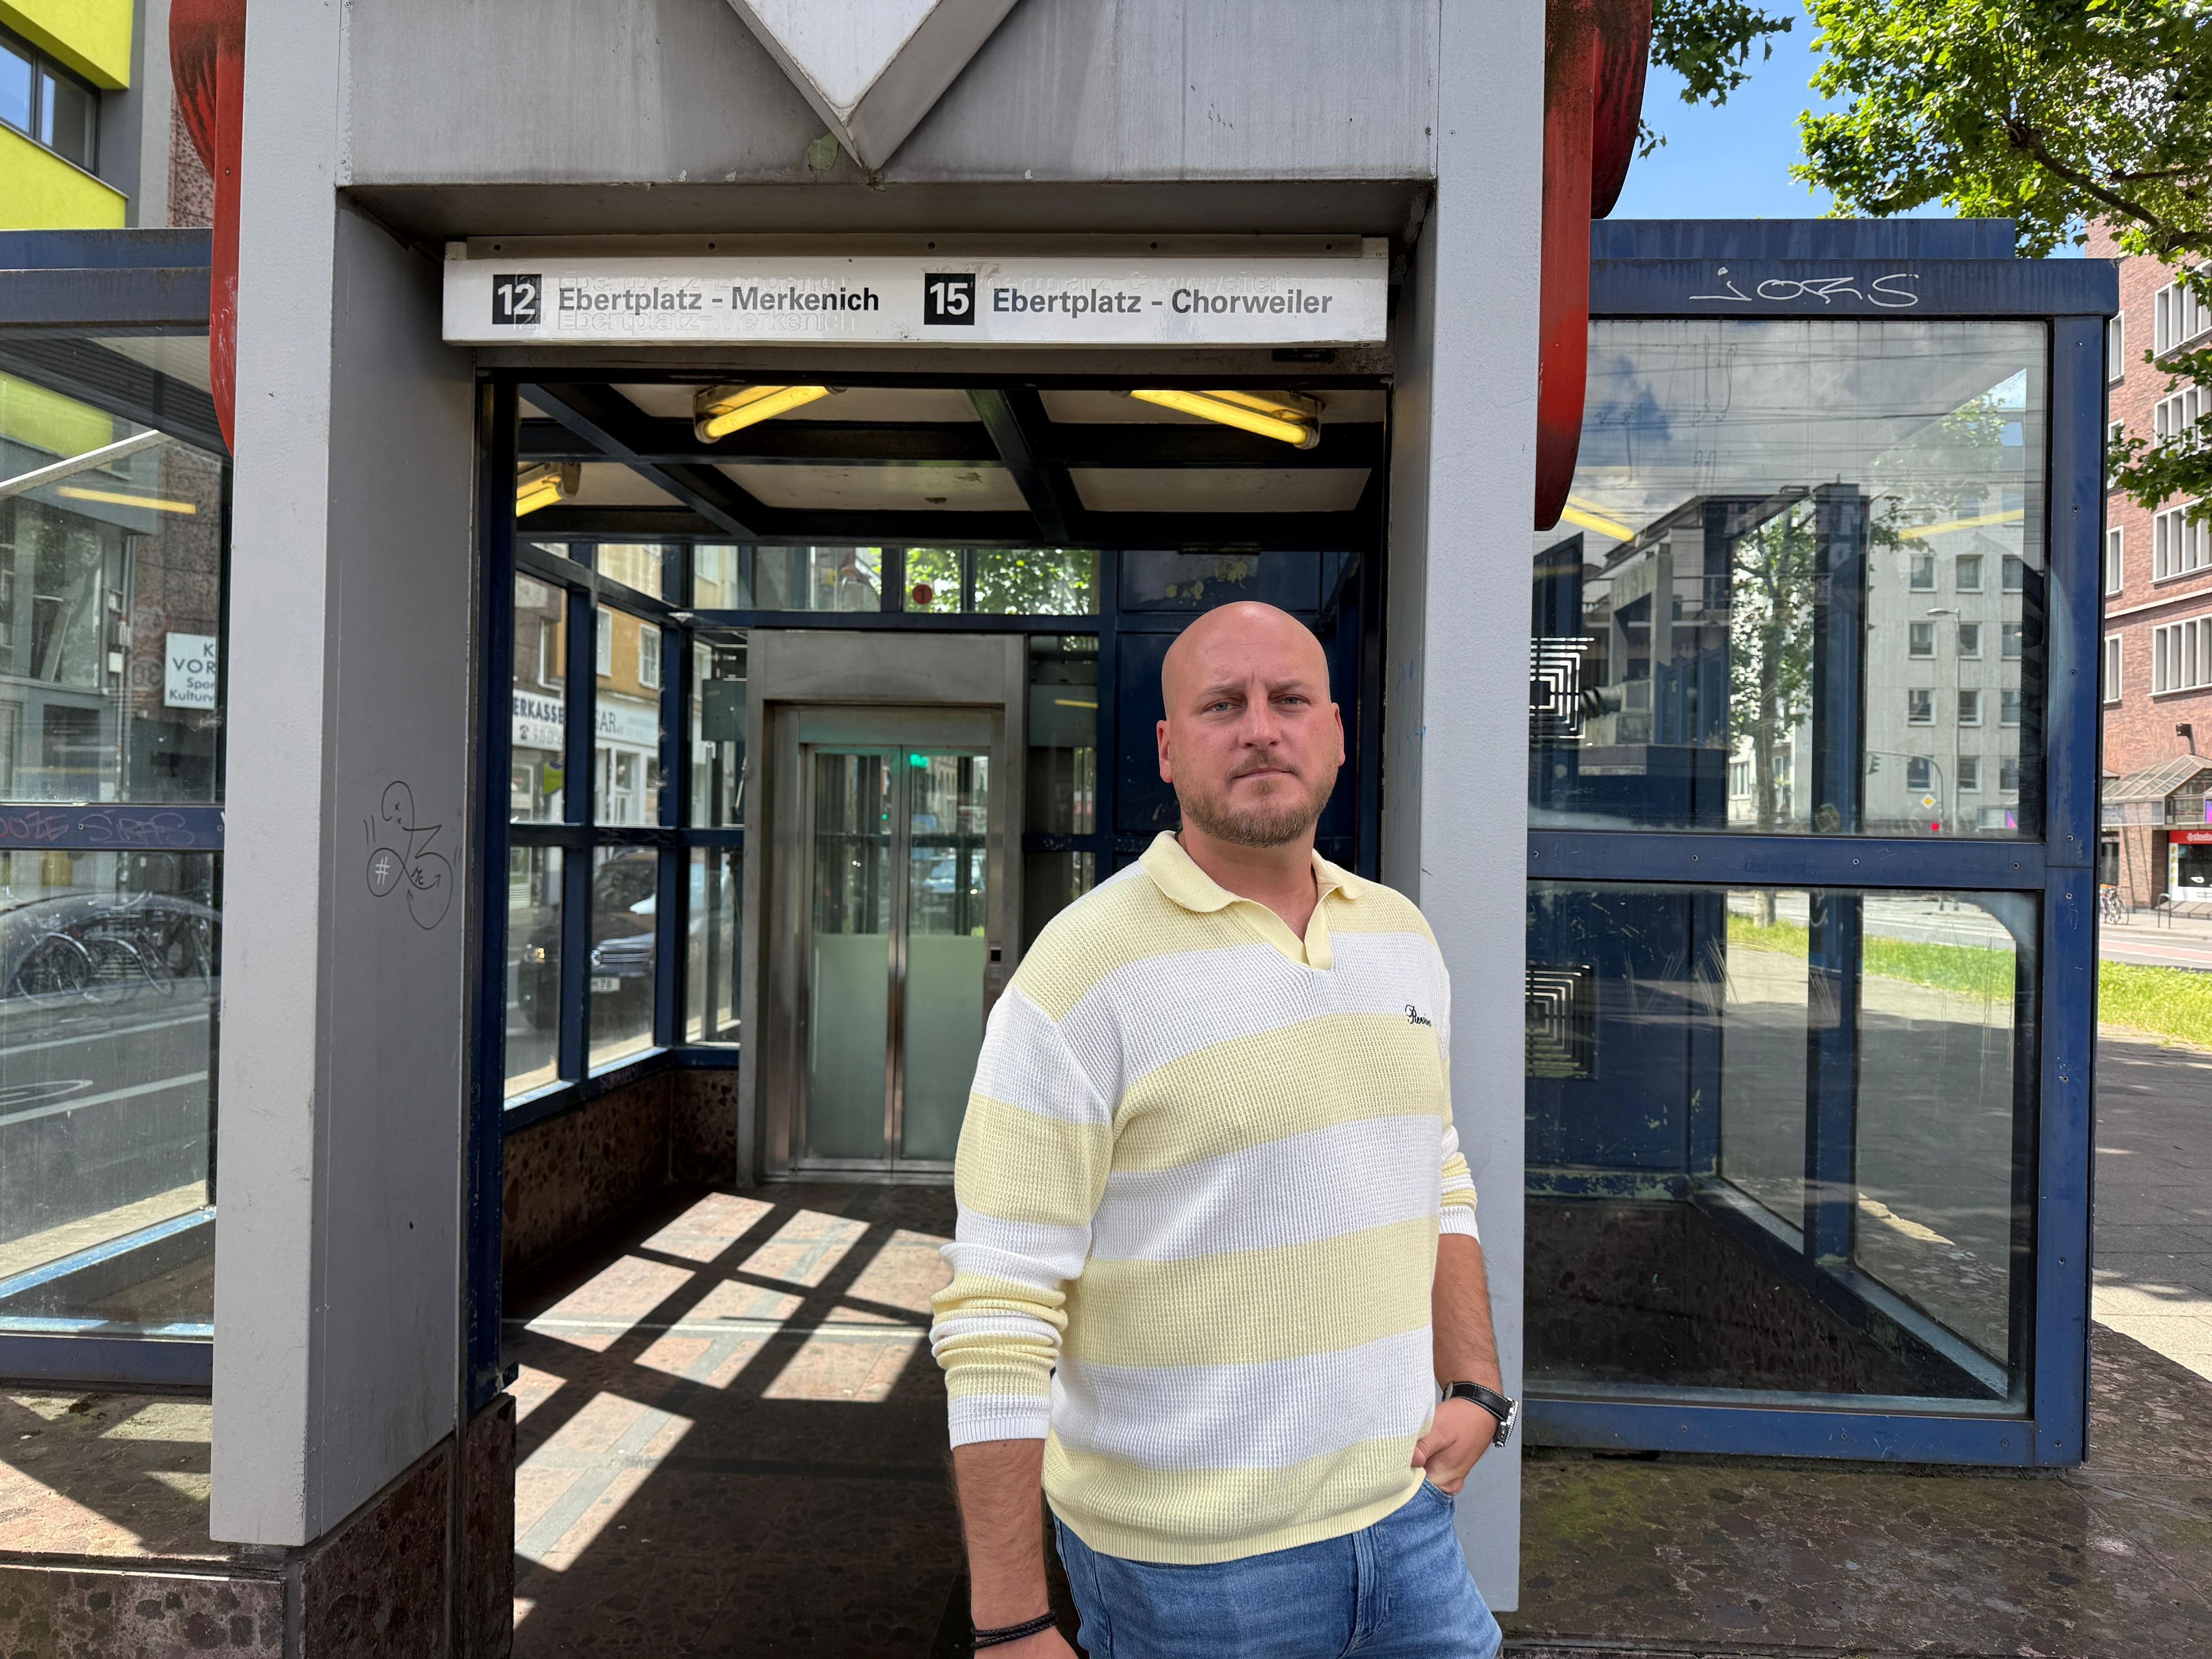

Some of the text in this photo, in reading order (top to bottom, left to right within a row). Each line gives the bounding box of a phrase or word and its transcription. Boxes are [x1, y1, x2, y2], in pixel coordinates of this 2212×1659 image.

[497, 283, 536, 316] 12
[559, 286, 702, 316] Ebertplatz
[732, 286, 879, 311] Merkenich
[929, 282, 970, 316] 15
[993, 288, 1141, 319] Ebertplatz
[1172, 289, 1333, 314] Chorweiler
